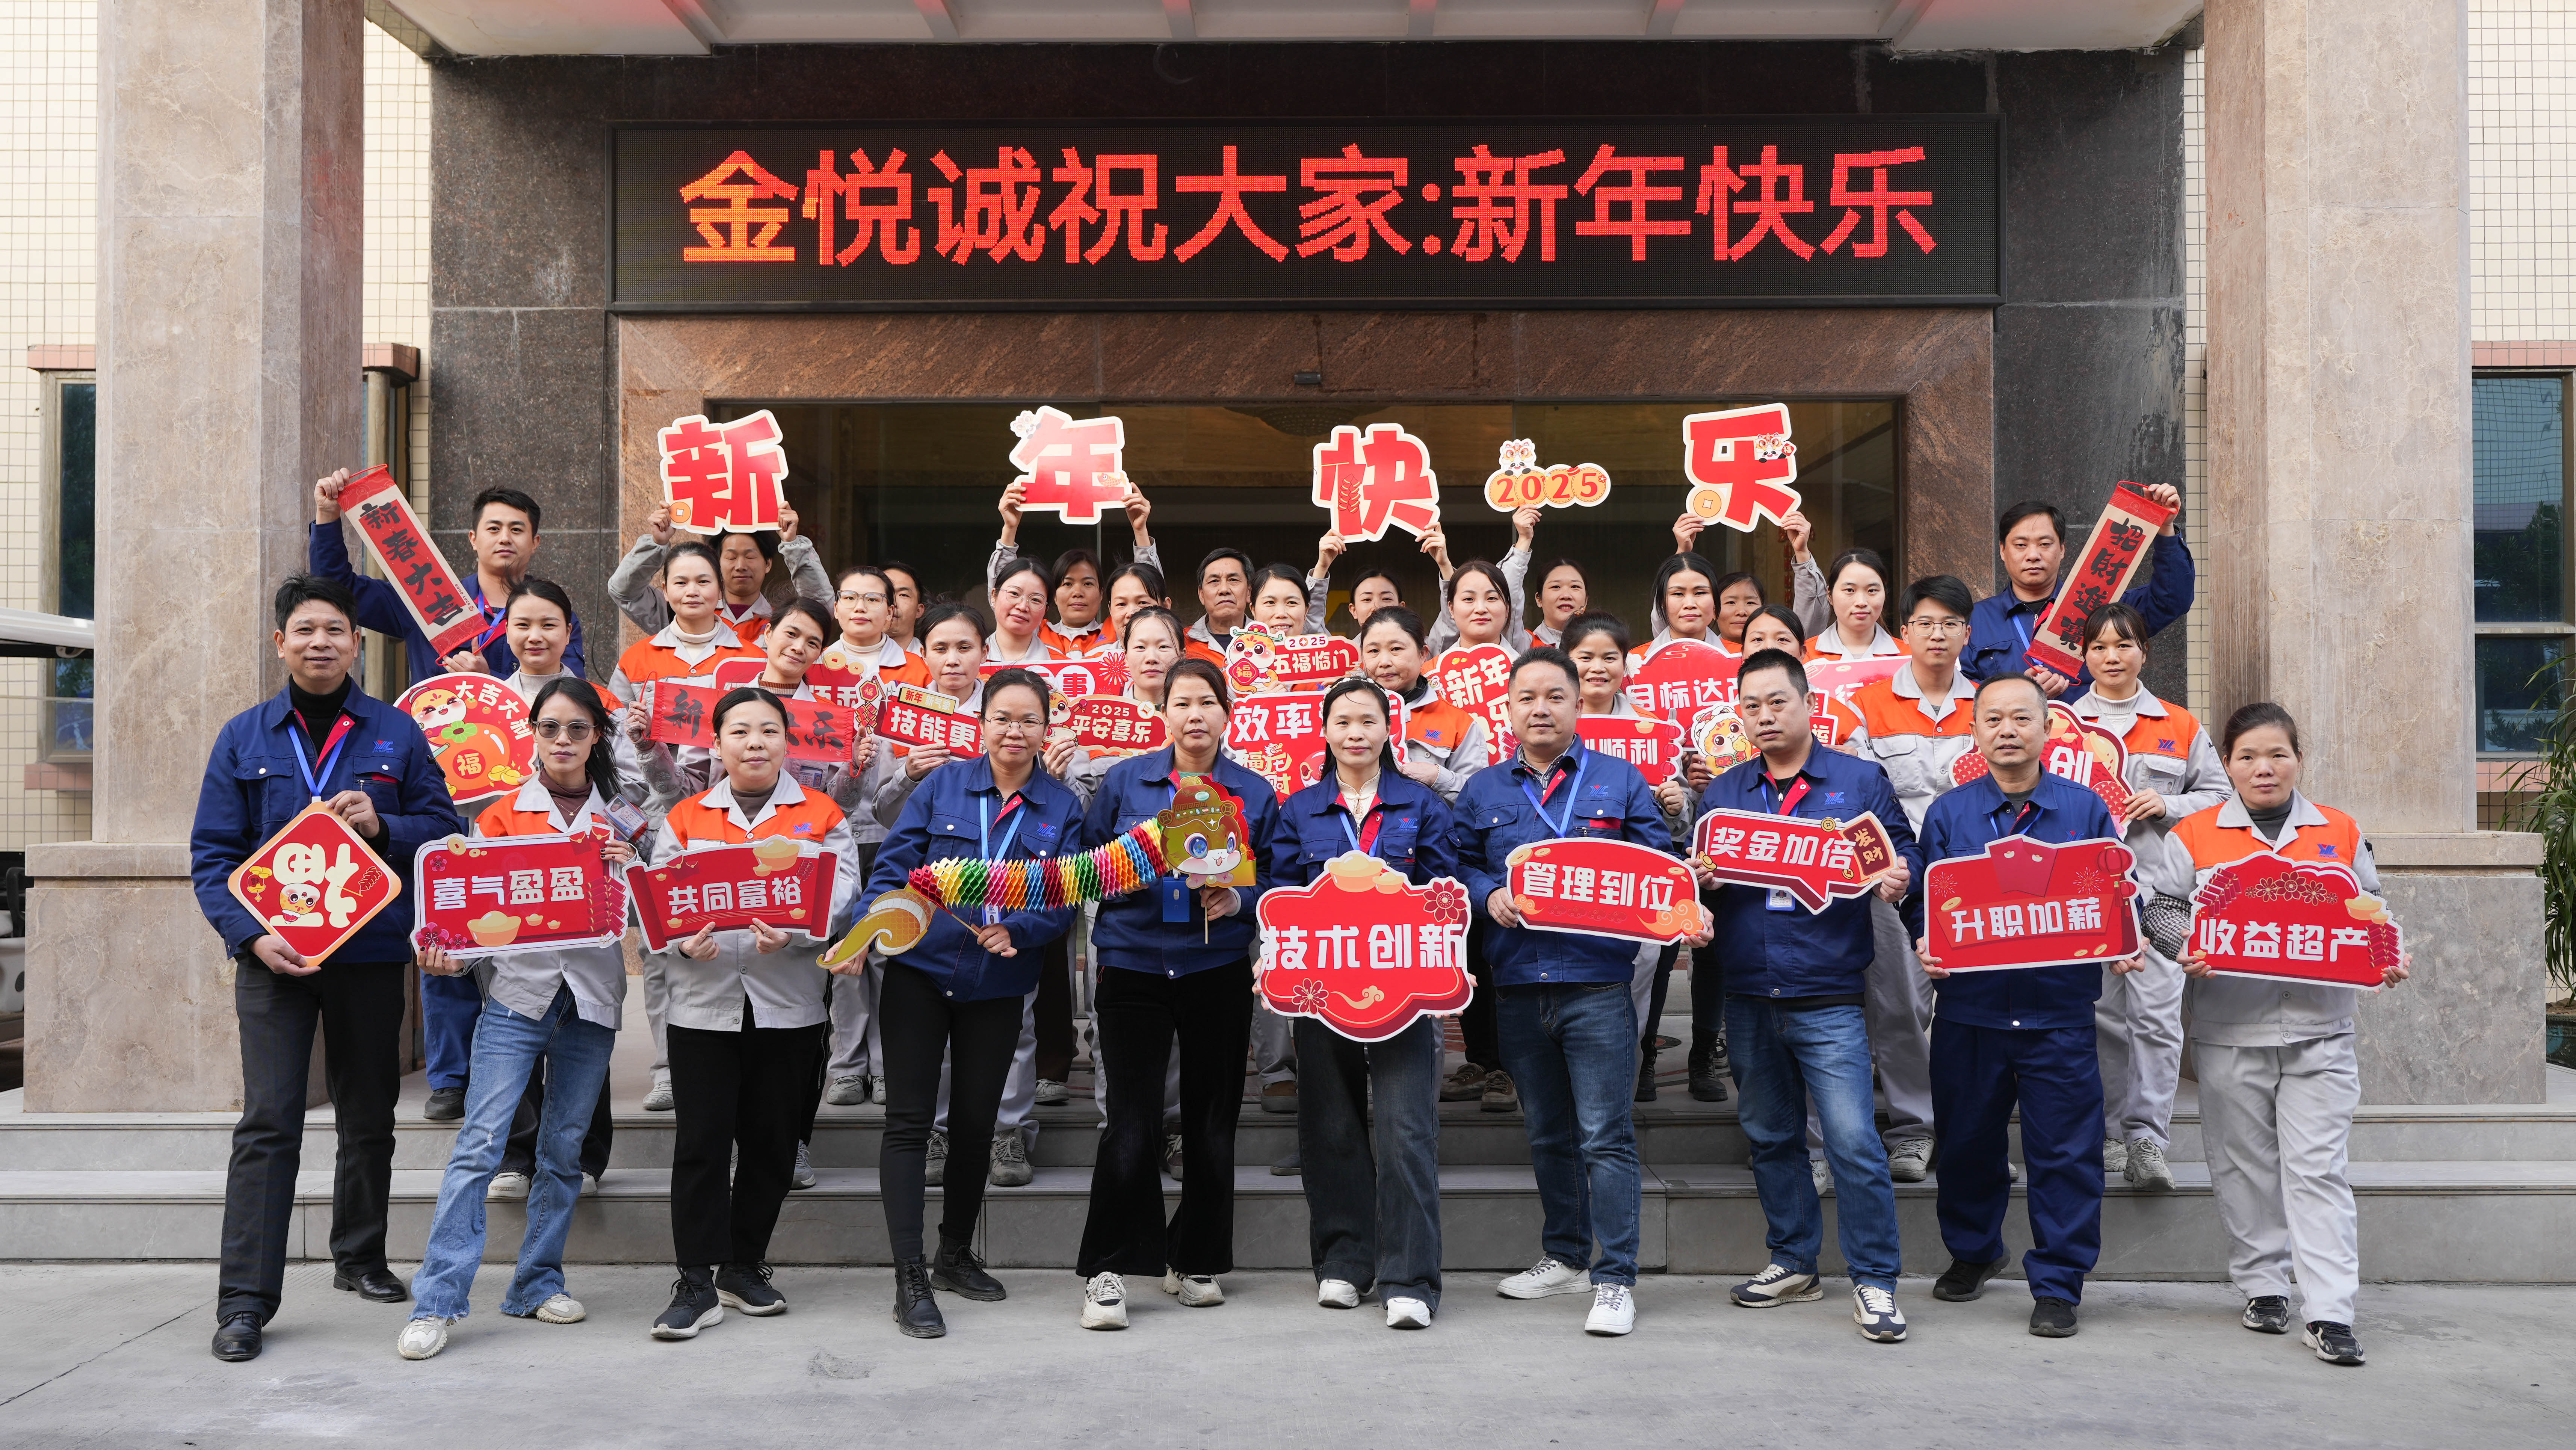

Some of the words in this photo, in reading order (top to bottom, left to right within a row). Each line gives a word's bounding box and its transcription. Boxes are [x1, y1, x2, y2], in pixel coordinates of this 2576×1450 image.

[665, 416, 781, 528] 新
[1017, 413, 1125, 517] 年
[1319, 431, 1434, 536] 快
[1691, 410, 1795, 525] 乐
[1497, 472, 1598, 503] 2025
[360, 503, 462, 626] 新春大吉
[455, 584, 463, 594] GOOD
[1236, 664, 1253, 677] 福
[1274, 649, 1350, 674] 五福临门
[905, 690, 923, 703] 新年
[925, 695, 951, 711] 新气象
[890, 706, 984, 754] 技能更
[1070, 715, 1152, 743] 平安喜乐
[456, 752, 482, 776] 福
[1709, 827, 1856, 870] 奖金加倍
[1855, 828, 1884, 865] 发财
[432, 866, 585, 910] 喜气盈盈
[668, 876, 802, 915] 共同富裕
[1522, 862, 1674, 912] 管理到位
[1951, 897, 2101, 943] 升职加薪
[2199, 918, 2368, 962] 收益超产
[1264, 923, 1464, 971] 技术创新
